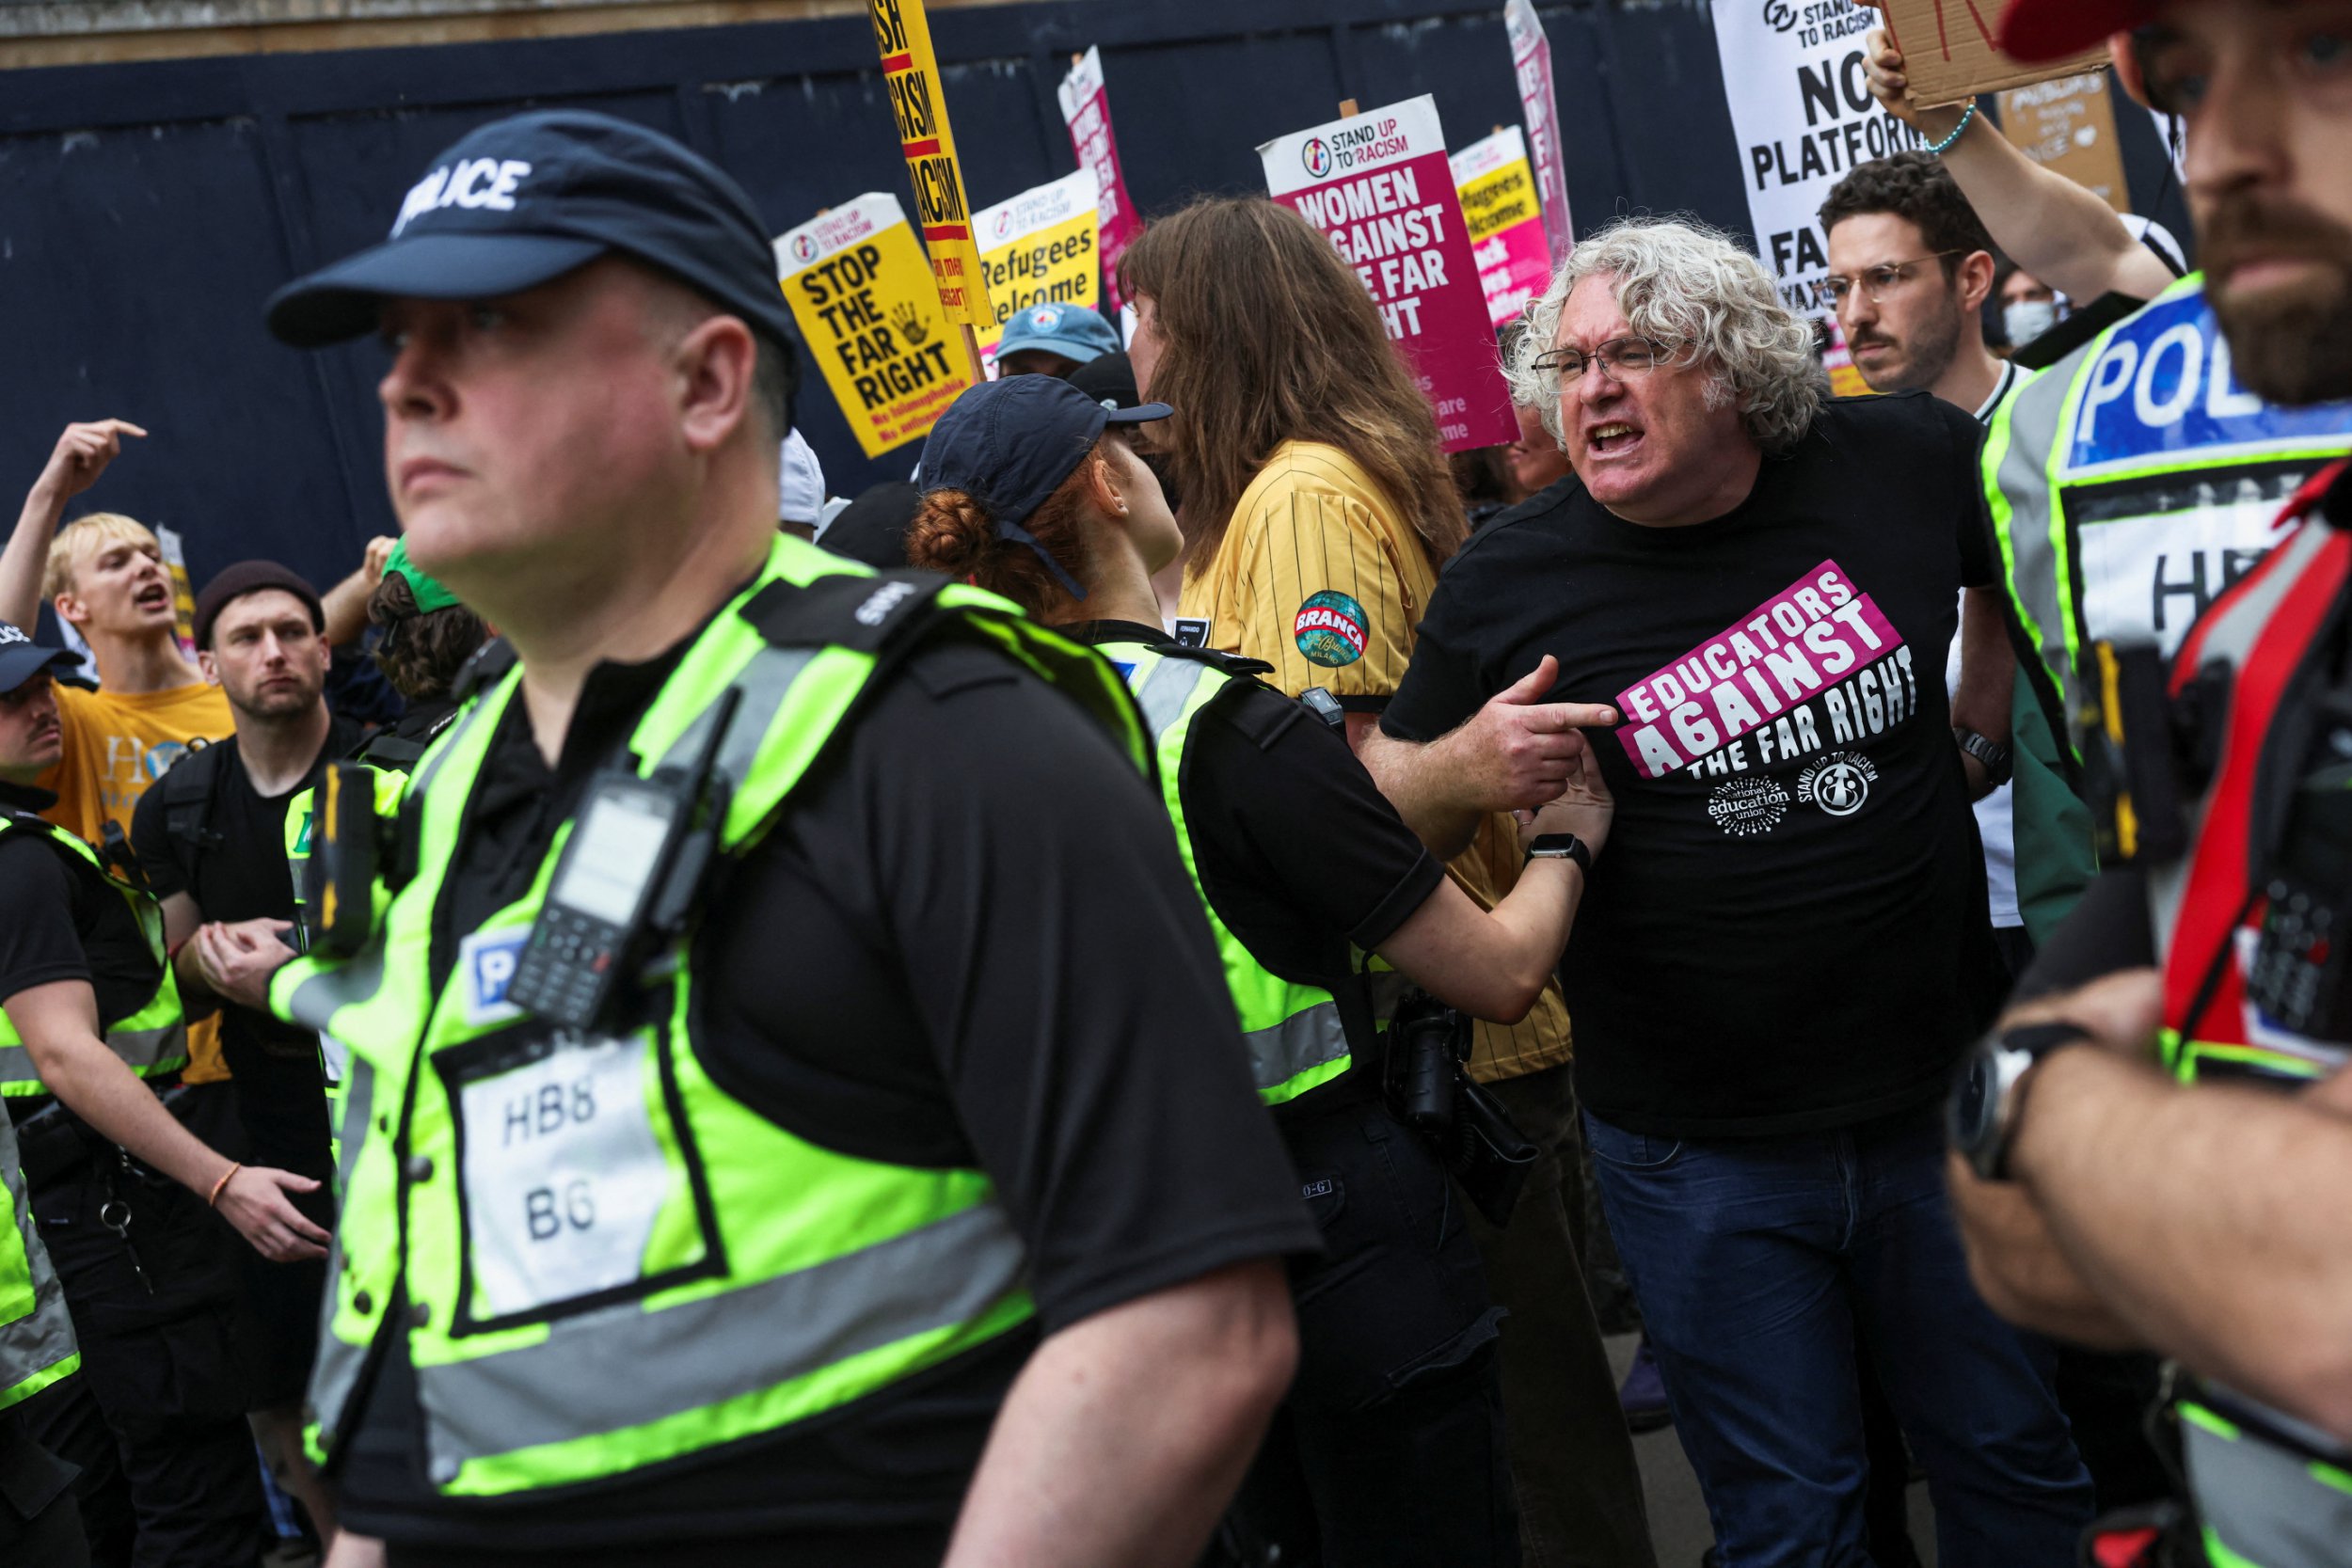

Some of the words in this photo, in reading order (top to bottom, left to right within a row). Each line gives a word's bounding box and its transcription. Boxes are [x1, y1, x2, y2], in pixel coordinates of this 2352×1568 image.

[1798, 28, 1819, 48] TO
[1822, 8, 1875, 41] RACISM
[1798, 51, 1873, 126] NO
[1331, 125, 1375, 150] STAND
[1378, 119, 1397, 138] UP
[1336, 150, 1353, 169] TO
[1356, 135, 1408, 164] RACISM
[1295, 166, 1421, 230] WOMEN
[1329, 203, 1445, 264] GAINST
[802, 245, 881, 305] STOP
[1379, 249, 1449, 299] FAR
[818, 290, 884, 339] THE
[988, 273, 1087, 327] elcome
[836, 326, 899, 376] FAR
[854, 341, 951, 410] RIGHT
[1438, 397, 1467, 417] are
[2077, 323, 2263, 441] POL
[1296, 610, 1363, 652] BRANCA
[1628, 571, 1851, 723] EDUCATORS
[1310, 651, 1339, 664] MILANO
[1633, 599, 1883, 778] AGAINST
[1686, 739, 1748, 780] THE
[1756, 705, 1821, 764] FAR
[1824, 644, 1916, 744] RIGHT
[1725, 786, 1766, 800] national
[1797, 768, 1816, 803] STAND
[1813, 756, 1828, 770] UP
[1831, 751, 1845, 763] TO
[1845, 751, 1879, 783] RACISM
[1708, 791, 1790, 816] education
[1736, 807, 1766, 820] union
